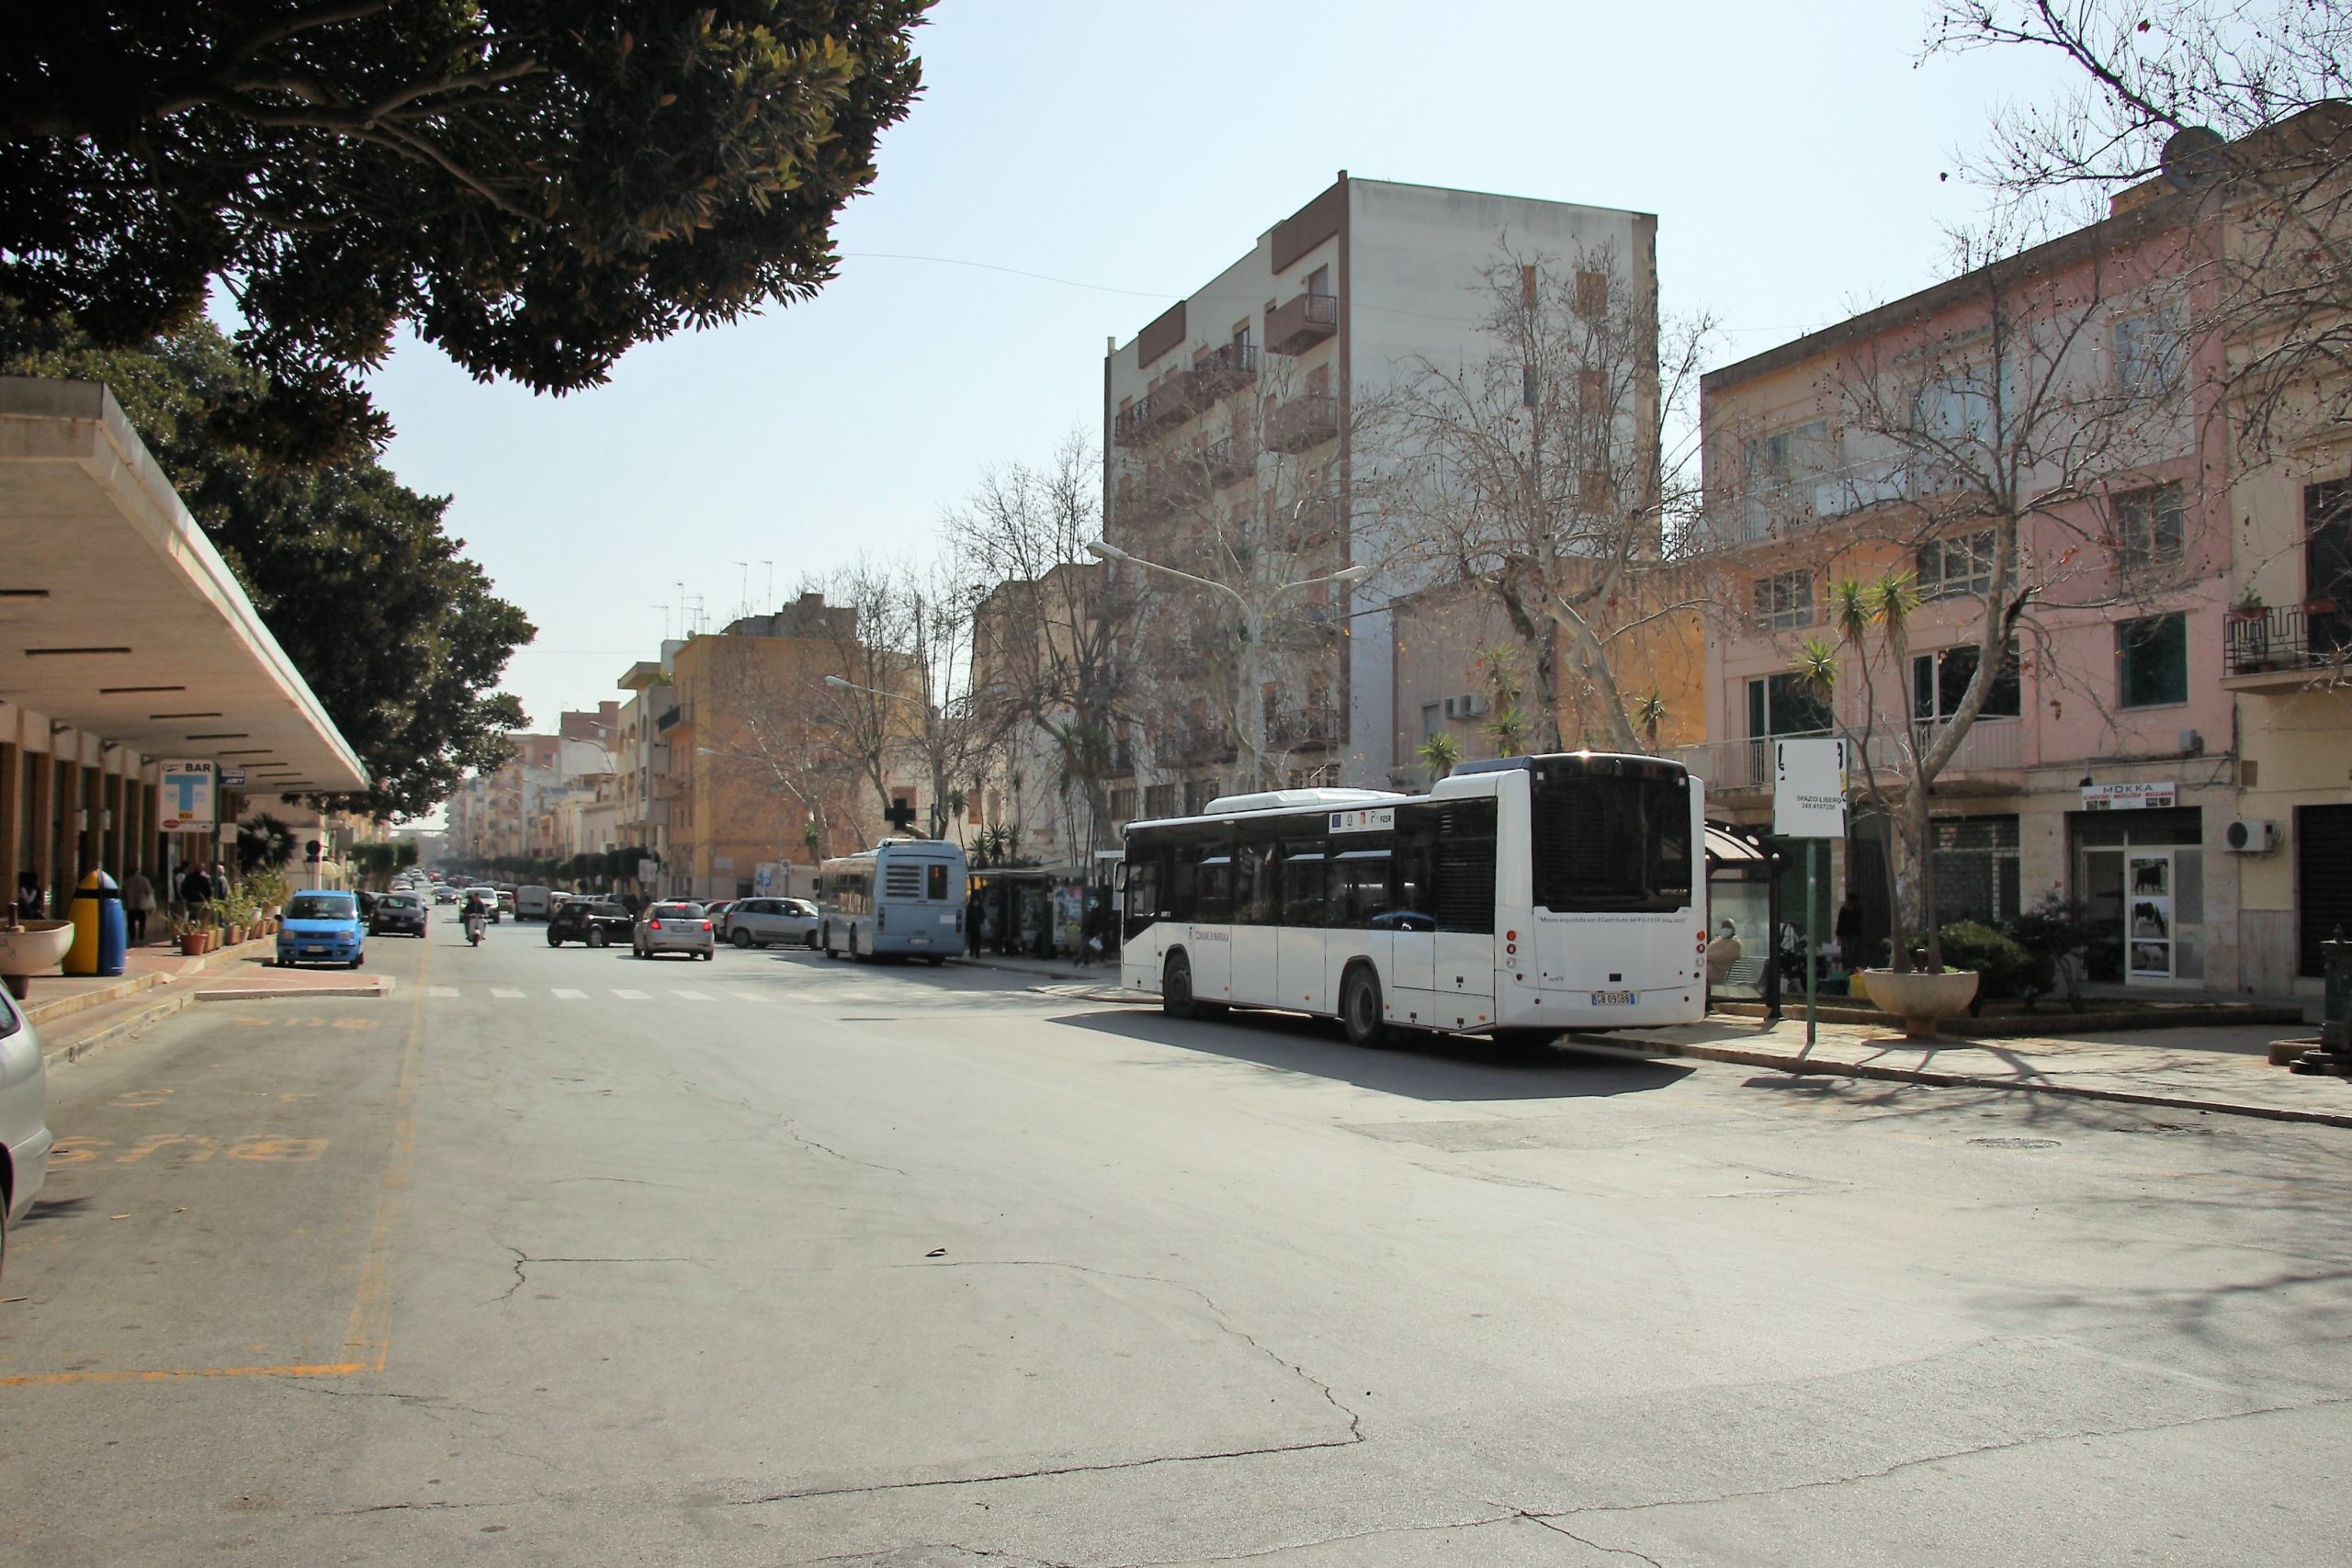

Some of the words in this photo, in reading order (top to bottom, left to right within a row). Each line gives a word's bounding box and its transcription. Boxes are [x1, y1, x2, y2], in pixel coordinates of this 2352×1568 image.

[186, 763, 211, 773] BAR
[2103, 784, 2154, 795] MOKKA
[1796, 795, 1818, 803] SPAZIO
